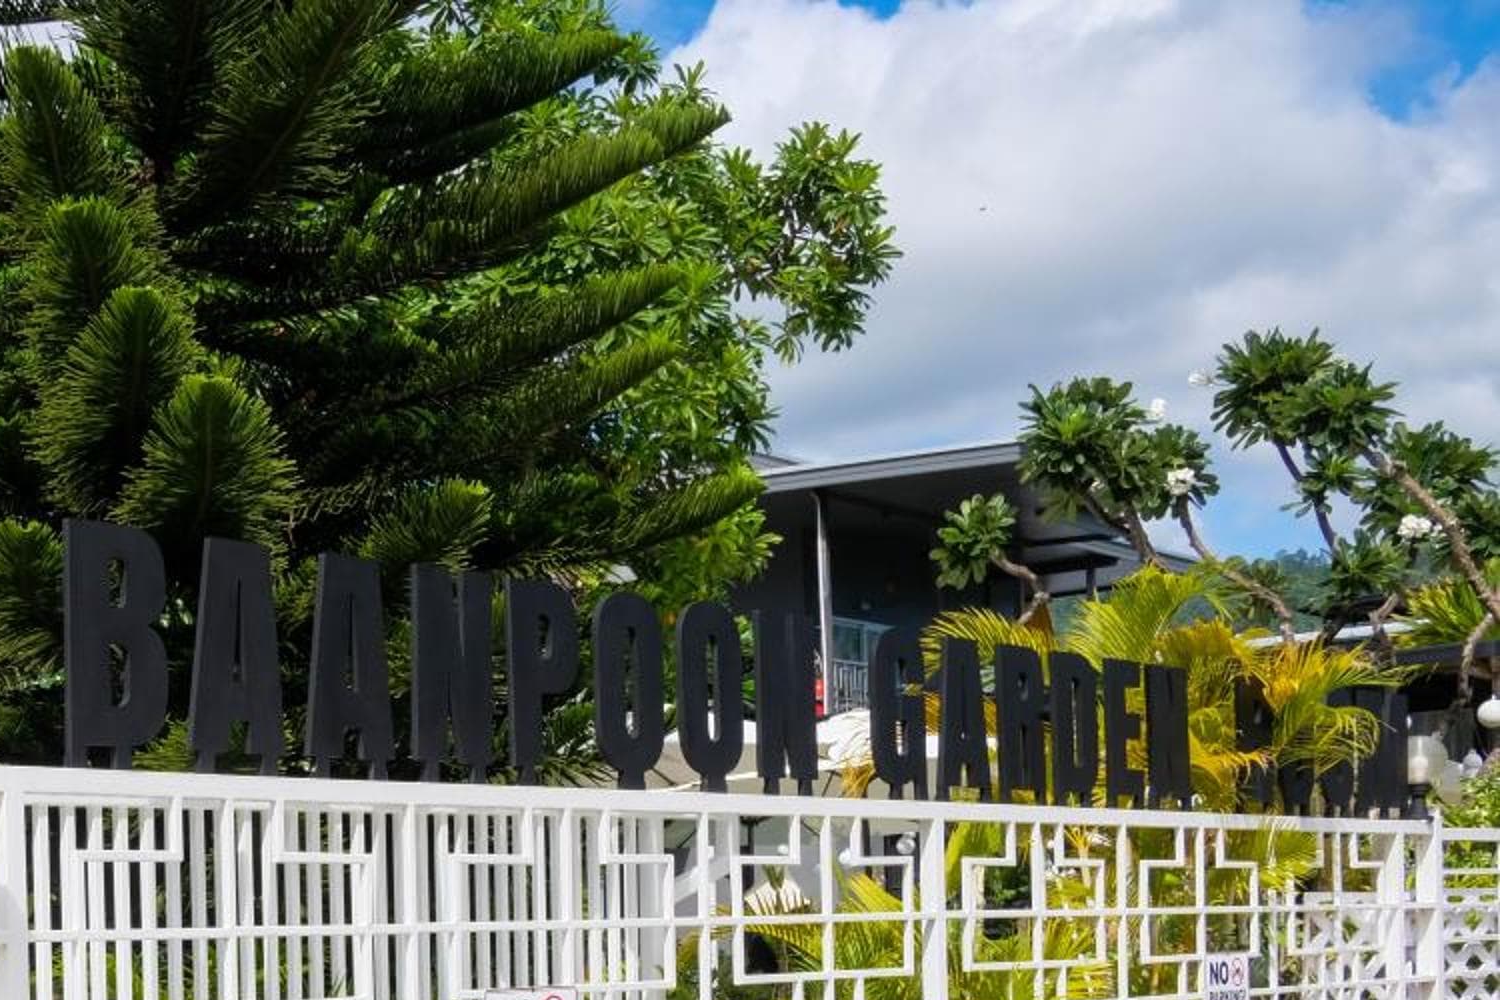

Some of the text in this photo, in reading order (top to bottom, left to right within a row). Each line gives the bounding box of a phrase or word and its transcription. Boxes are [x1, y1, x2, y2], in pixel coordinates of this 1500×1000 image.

[62, 518, 817, 780] BAANPOON
[869, 626, 1191, 801] GARDEN
[1209, 961, 1229, 985] NO
